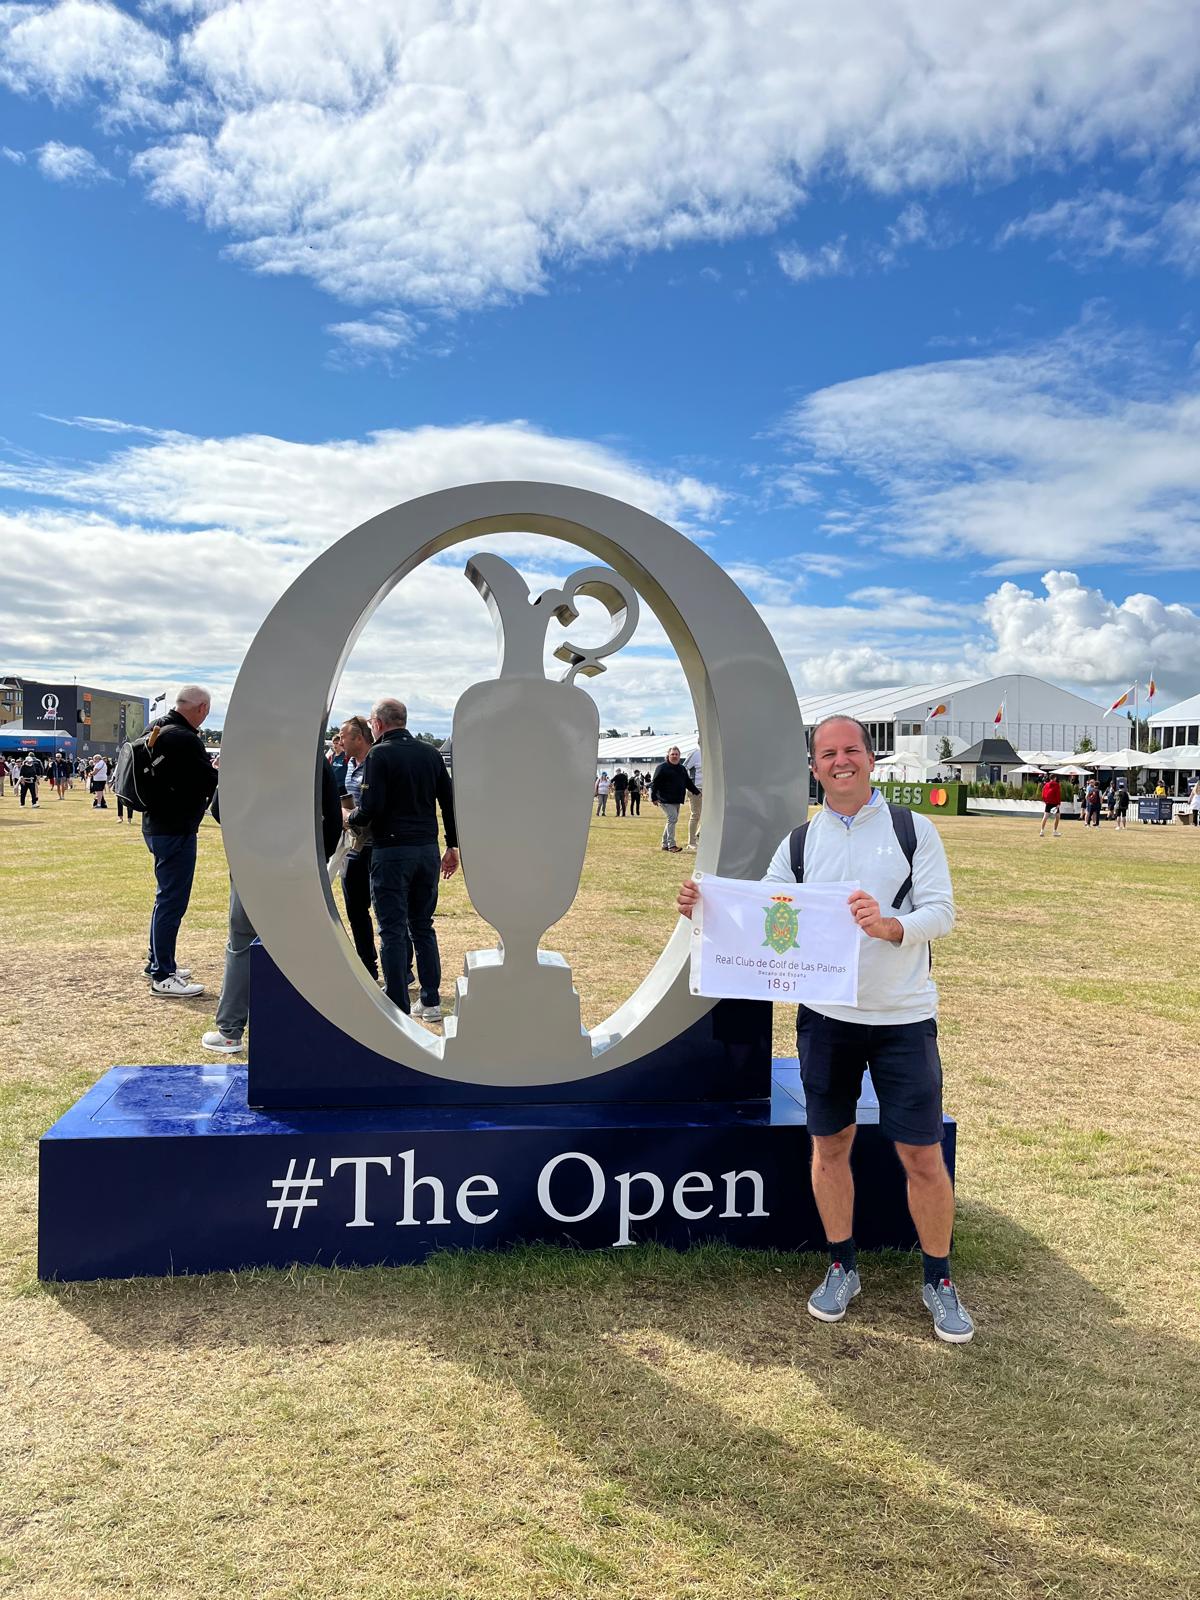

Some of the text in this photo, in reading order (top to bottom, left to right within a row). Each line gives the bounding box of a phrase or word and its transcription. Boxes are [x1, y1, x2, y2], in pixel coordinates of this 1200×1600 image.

[715, 954, 847, 973] Real Club de Golf de Las Palmas
[768, 978, 796, 992] 1891
[266, 1148, 770, 1247] #The Open
